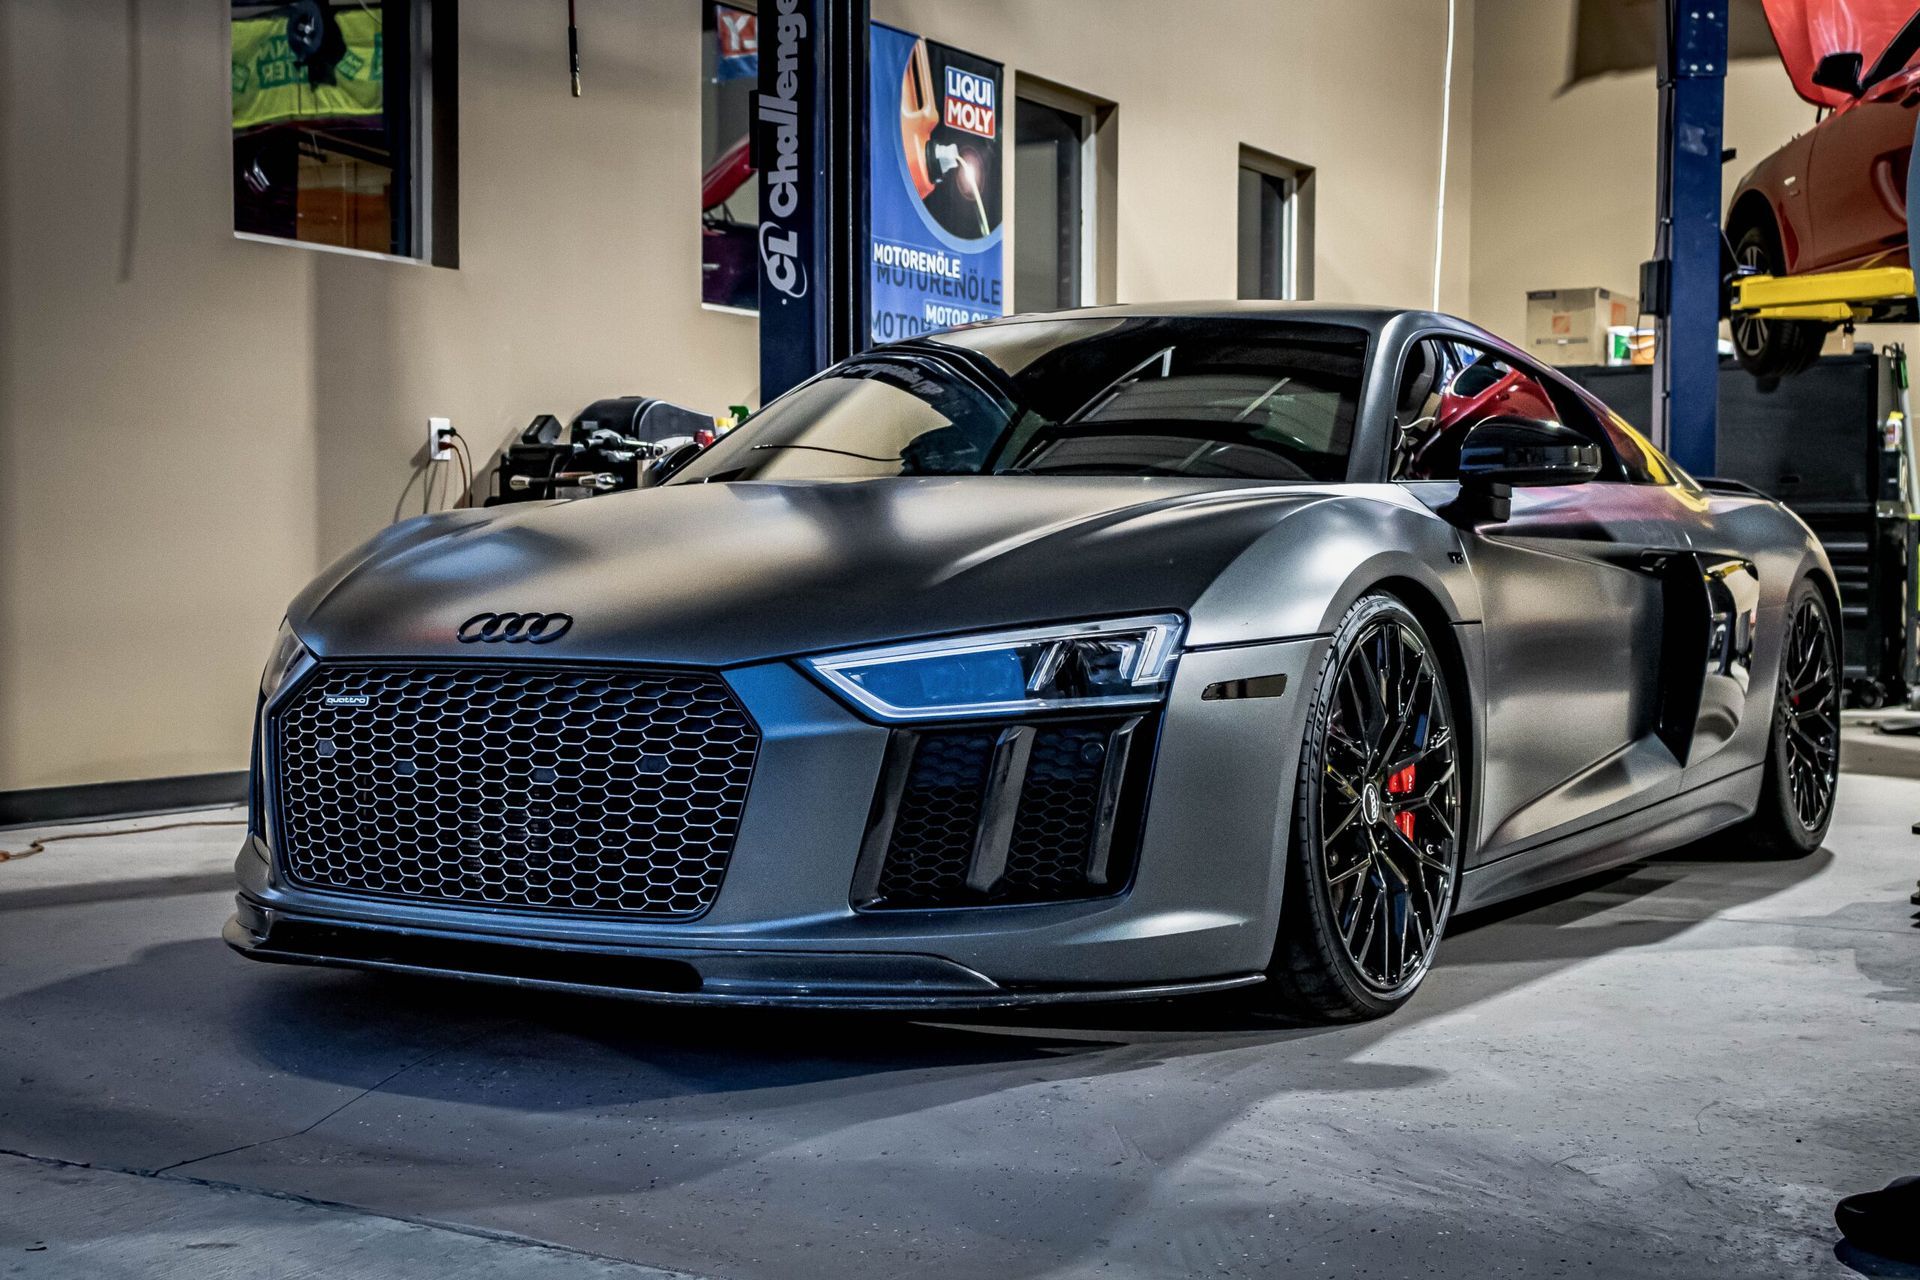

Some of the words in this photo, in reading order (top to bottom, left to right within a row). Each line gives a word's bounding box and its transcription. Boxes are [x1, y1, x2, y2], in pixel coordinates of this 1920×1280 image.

[947, 70, 992, 107] LIQUI
[947, 99, 993, 134] MOLY
[873, 242, 961, 279] MOTORENÖLE
[925, 303, 970, 327] MOTOR
